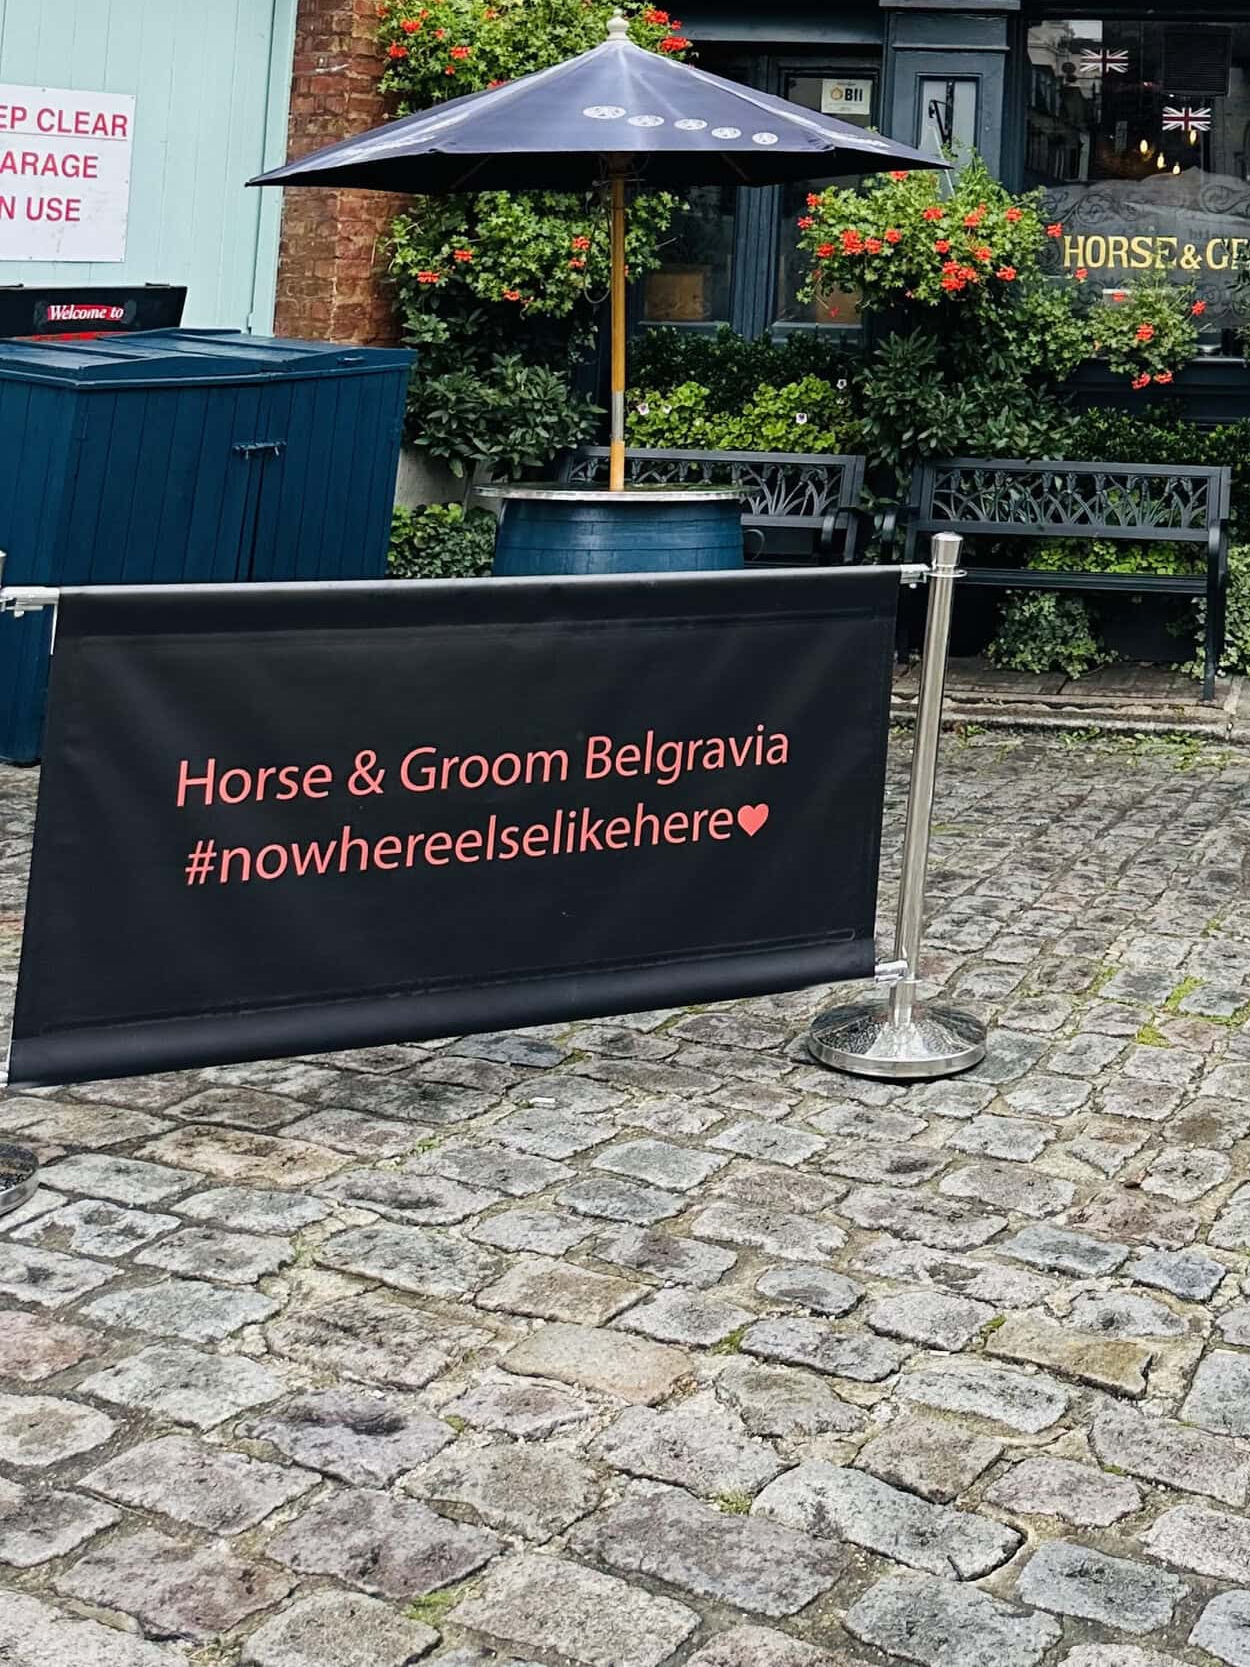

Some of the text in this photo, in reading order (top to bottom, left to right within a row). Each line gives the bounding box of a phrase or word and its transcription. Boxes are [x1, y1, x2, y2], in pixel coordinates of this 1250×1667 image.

[37, 108, 128, 137] CLEAR
[0, 150, 98, 178] ARAGE
[26, 197, 82, 222] USE
[1062, 235, 1178, 270] HORSE
[1180, 244, 1202, 270] &
[49, 304, 124, 321] Welcome to
[175, 724, 791, 807] Horse & Groom Belgravia
[183, 803, 736, 887] #nowhereelselikehere
